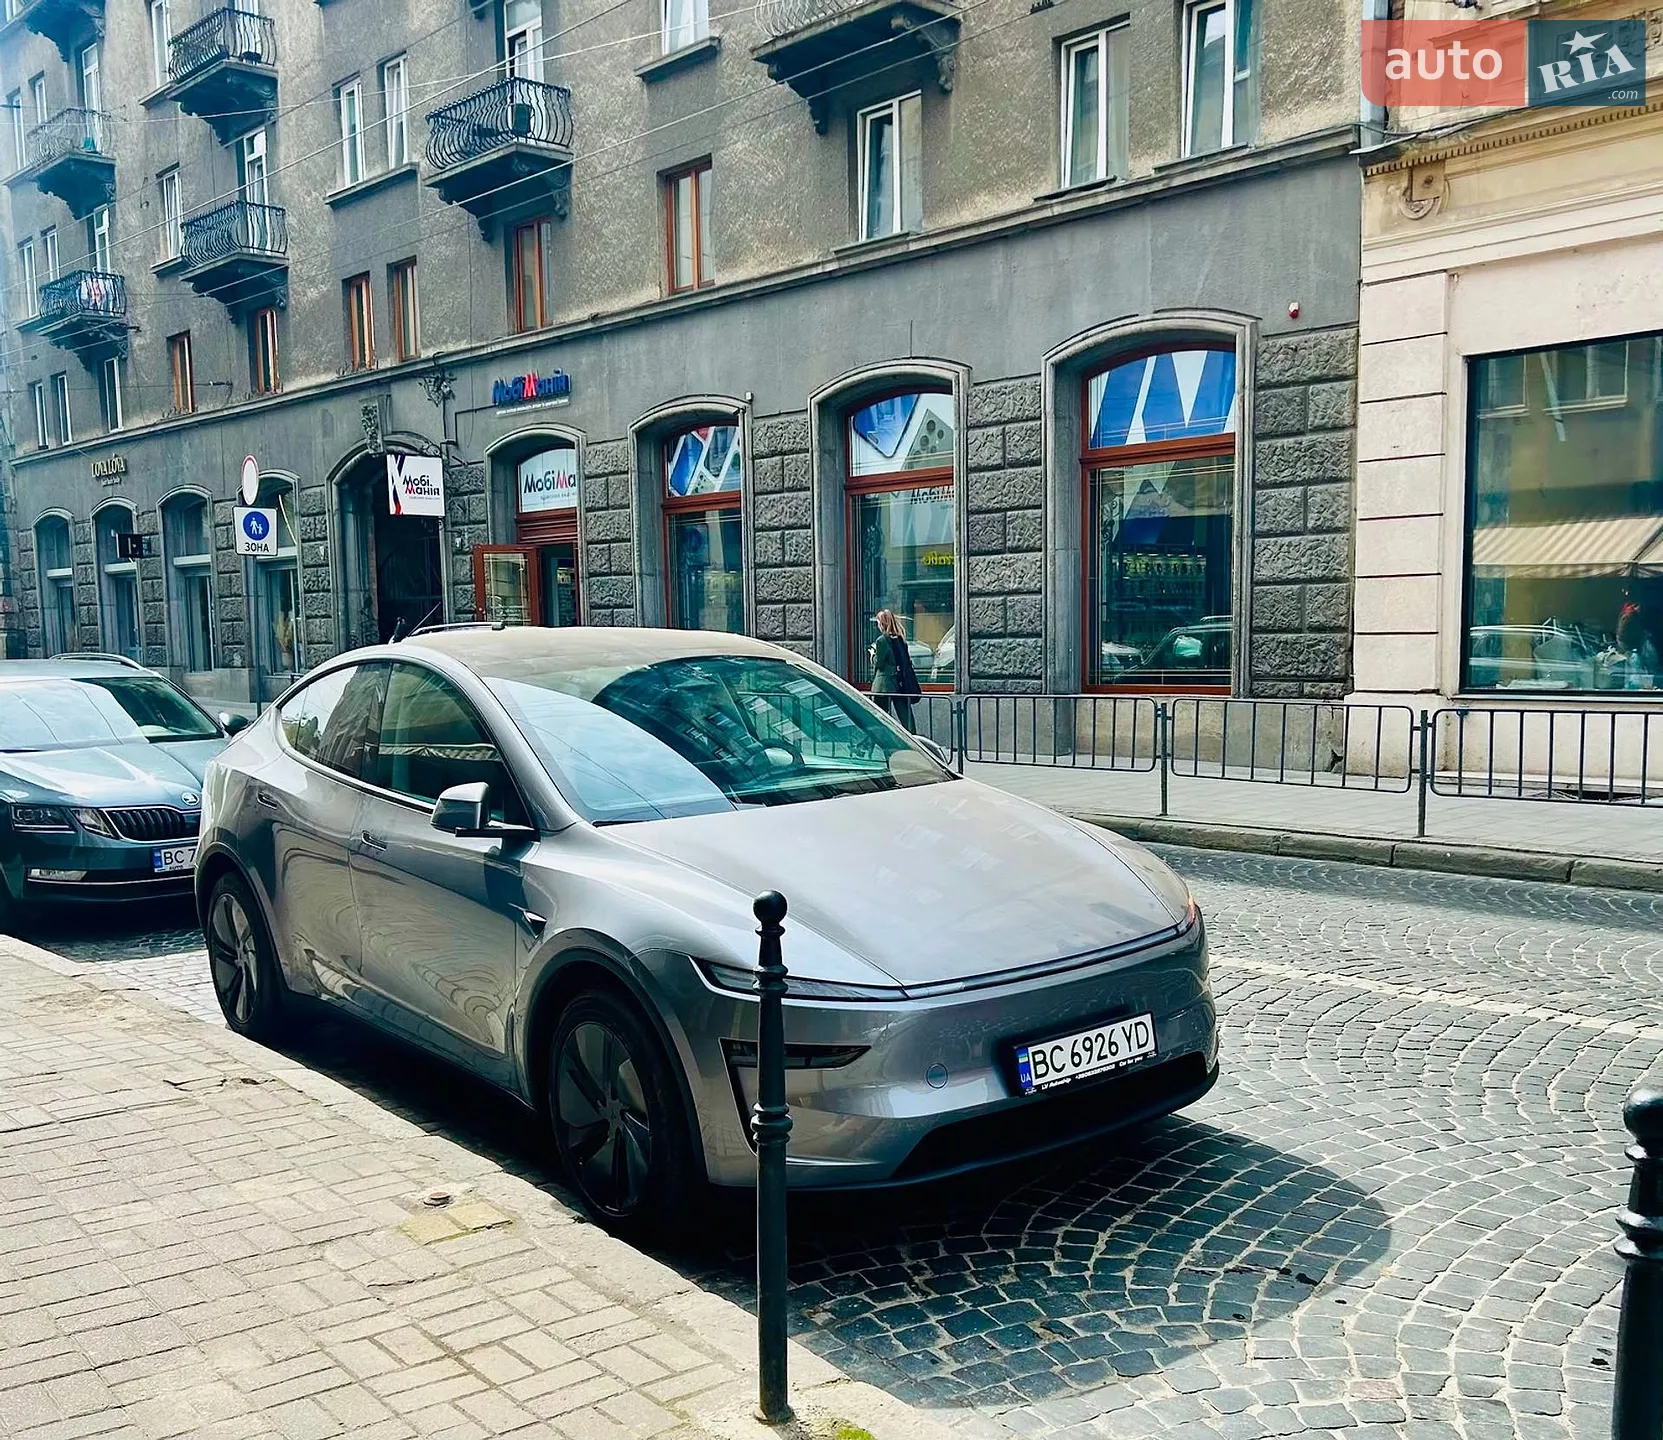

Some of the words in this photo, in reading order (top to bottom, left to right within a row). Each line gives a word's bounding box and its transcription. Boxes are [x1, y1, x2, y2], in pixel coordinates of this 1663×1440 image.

[403, 475, 429, 486] Мобі
[244, 542, 270, 552] ЗОНА
[163, 850, 185, 865] BC
[1031, 1045, 1065, 1079] BC
[1070, 1029, 1119, 1067] 6926
[1121, 1021, 1150, 1053] YD
[1020, 1072, 1032, 1083] UA
